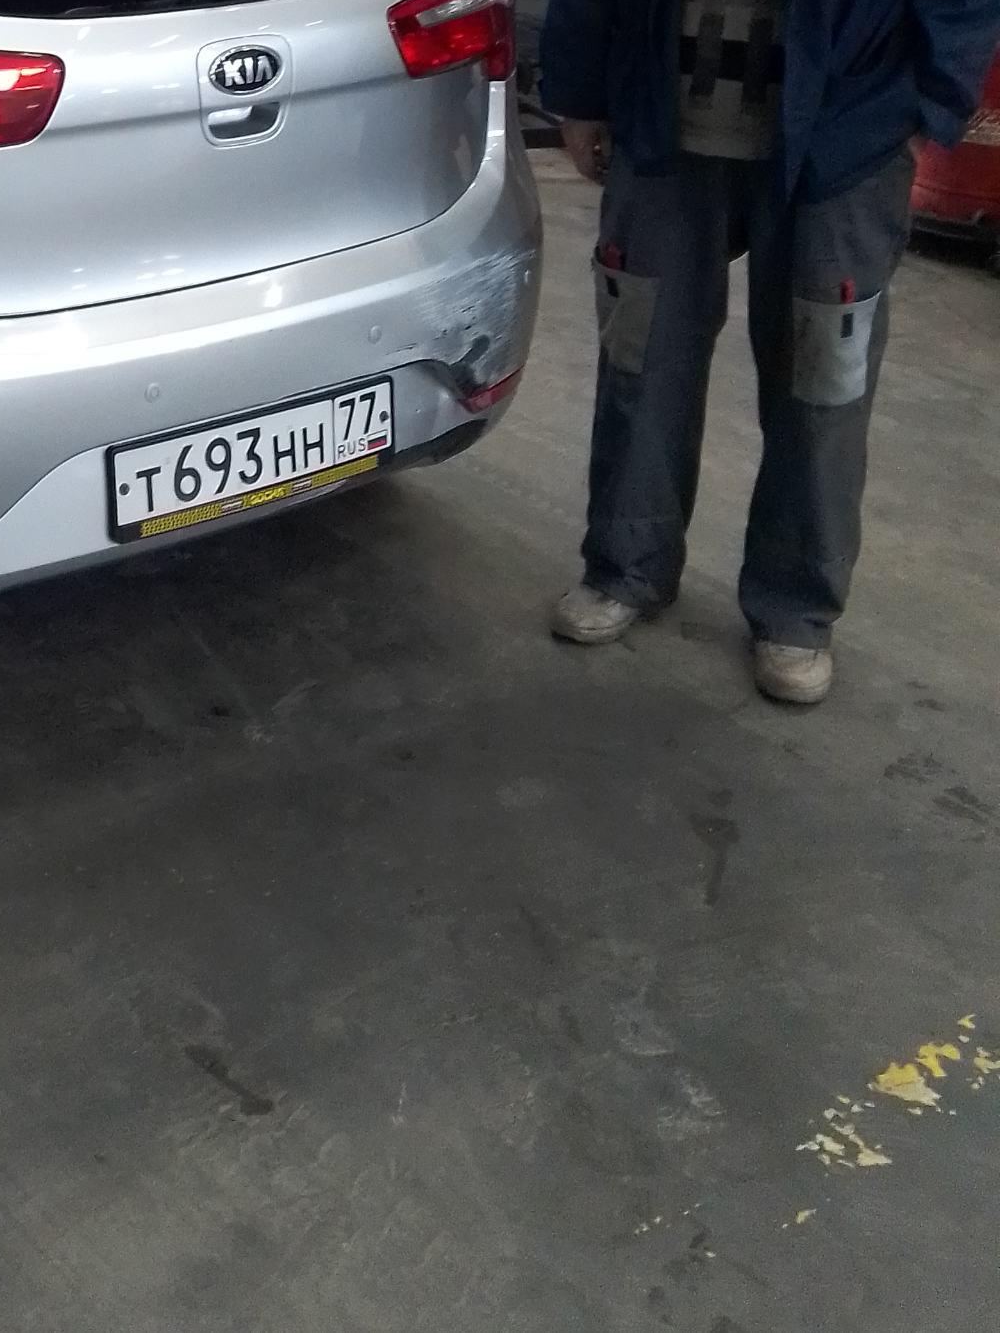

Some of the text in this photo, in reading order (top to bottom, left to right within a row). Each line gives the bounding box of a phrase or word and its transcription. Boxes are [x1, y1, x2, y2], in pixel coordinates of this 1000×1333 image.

[222, 55, 273, 87] KIA
[339, 391, 377, 441] 77
[337, 437, 367, 459] RUS
